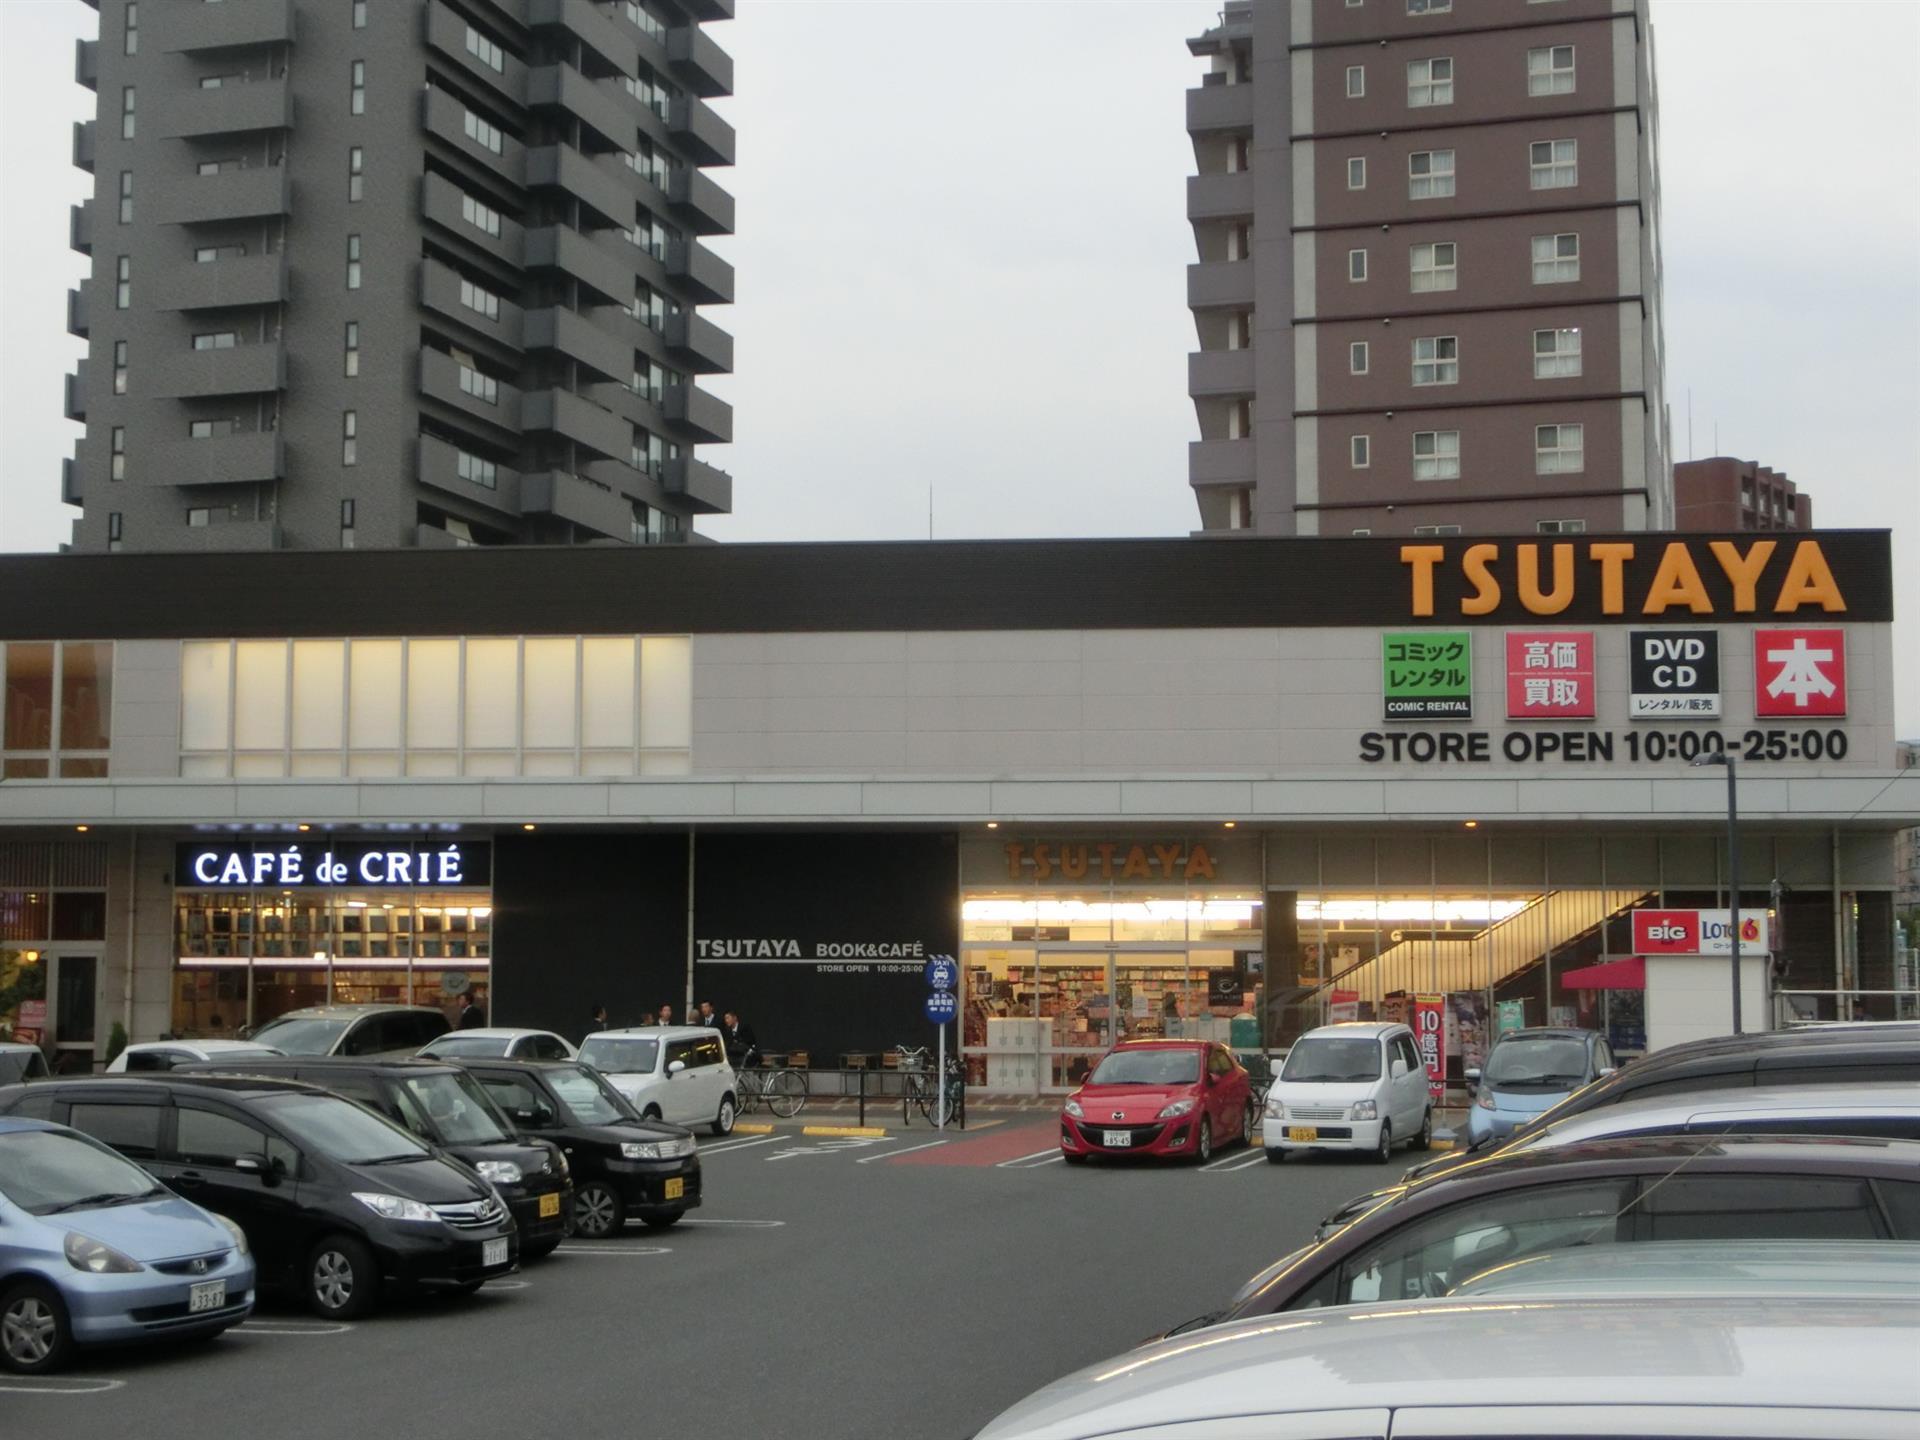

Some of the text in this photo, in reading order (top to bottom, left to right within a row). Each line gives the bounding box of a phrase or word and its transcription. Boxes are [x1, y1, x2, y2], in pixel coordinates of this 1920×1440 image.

[1400, 541, 1847, 616] TSUTAYA
[1388, 641, 1464, 662] コミック
[1524, 641, 1577, 669] 高価
[1645, 639, 1705, 660] DVD
[1390, 669, 1465, 687] レンタル
[1653, 665, 1697, 688] CD
[1766, 638, 1836, 706] 本
[1524, 678, 1579, 706] 買取
[1388, 702, 1468, 712] COMIC RENTAL
[1638, 699, 1713, 710] レンタル/販売
[1359, 729, 1848, 762] STORE OPEN 10:00-25:00
[195, 844, 462, 883] CAFÉ de CRIÉ
[1004, 842, 1217, 879] TSUTAYA
[697, 939, 923, 957] TSUTAYA BOOK&CAFÉ
[817, 964, 924, 973] STORE OPEN 10:00-25:00
